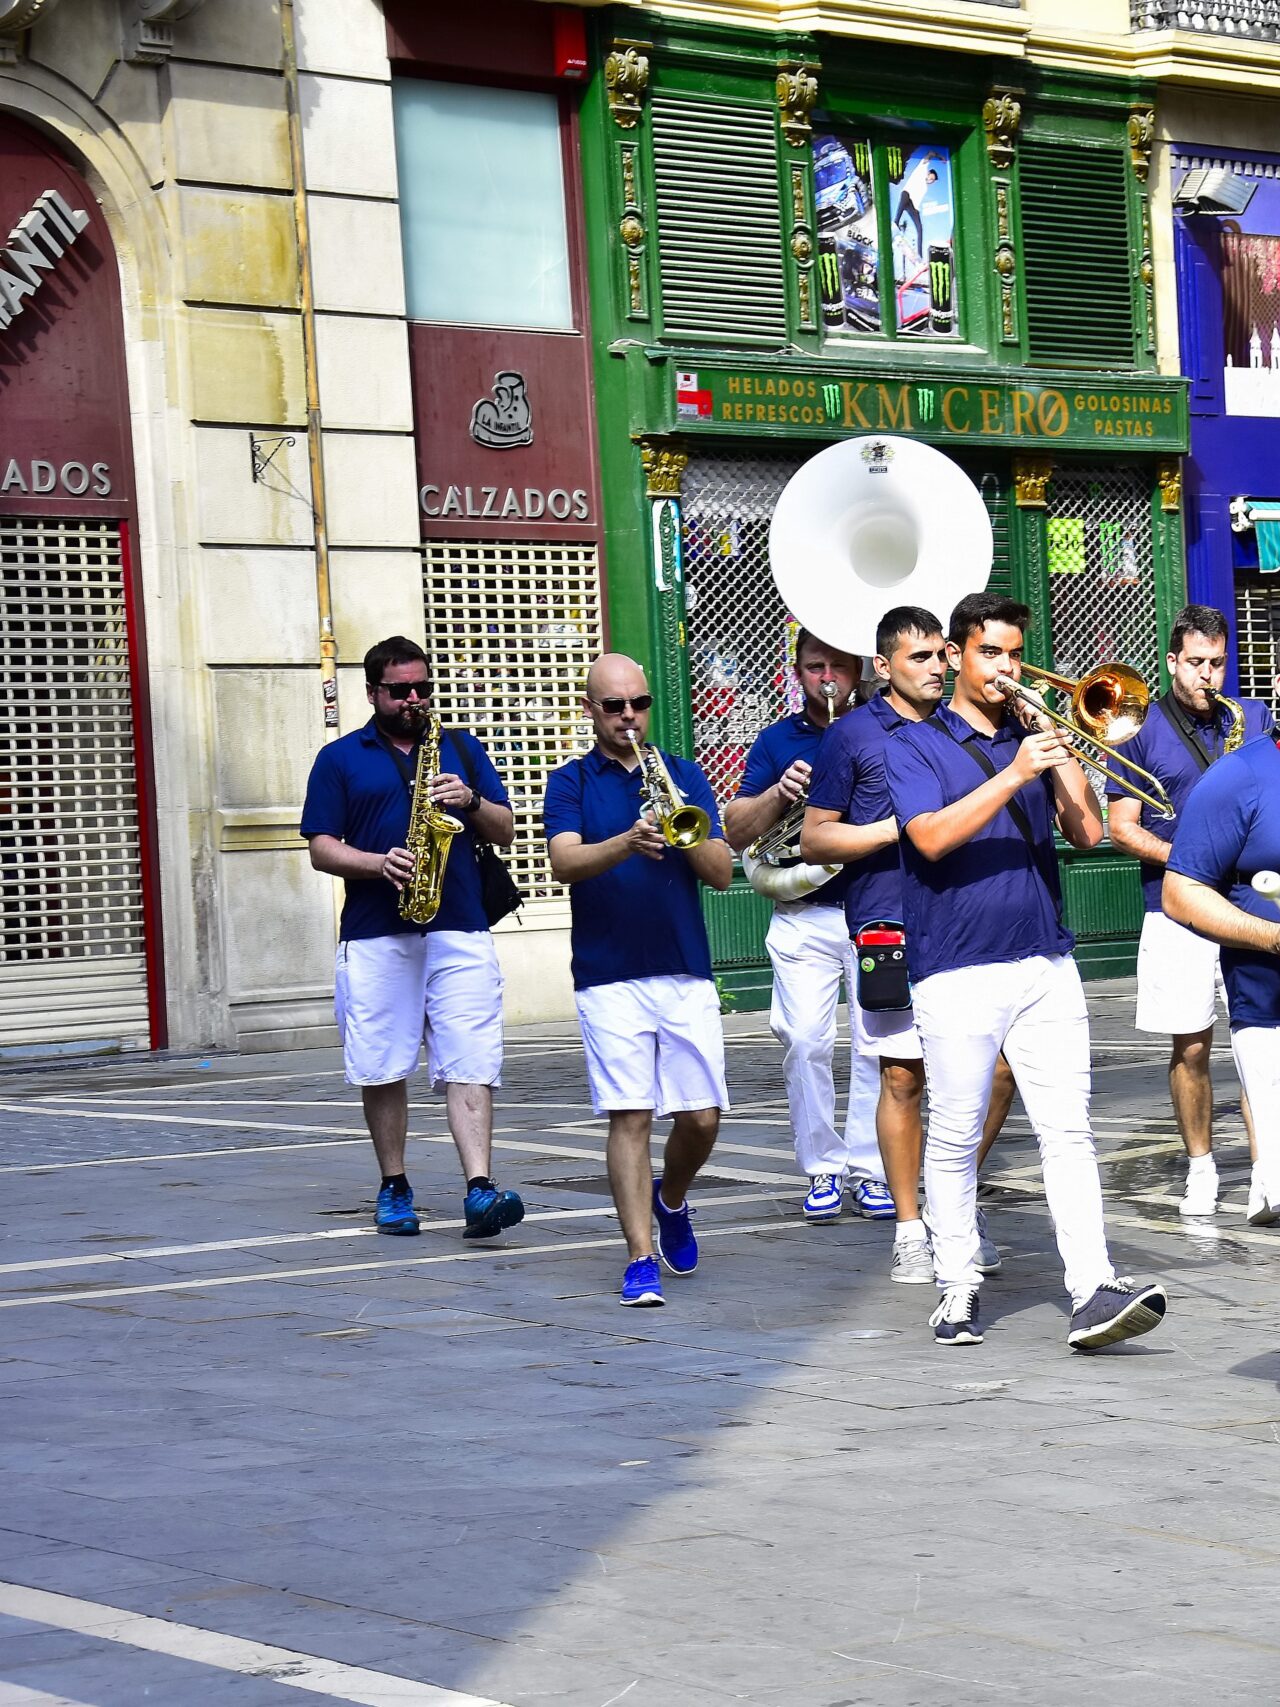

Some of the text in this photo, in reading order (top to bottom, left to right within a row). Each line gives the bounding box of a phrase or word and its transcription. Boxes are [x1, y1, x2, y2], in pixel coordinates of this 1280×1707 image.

[728, 377, 816, 398] HELADOS
[722, 402, 824, 424] REFRESCOS
[840, 381, 914, 431] KM
[1074, 394, 1173, 414] GOLOSINAS
[1094, 419, 1153, 437] PASTAS
[419, 484, 589, 520] CALZADOS
